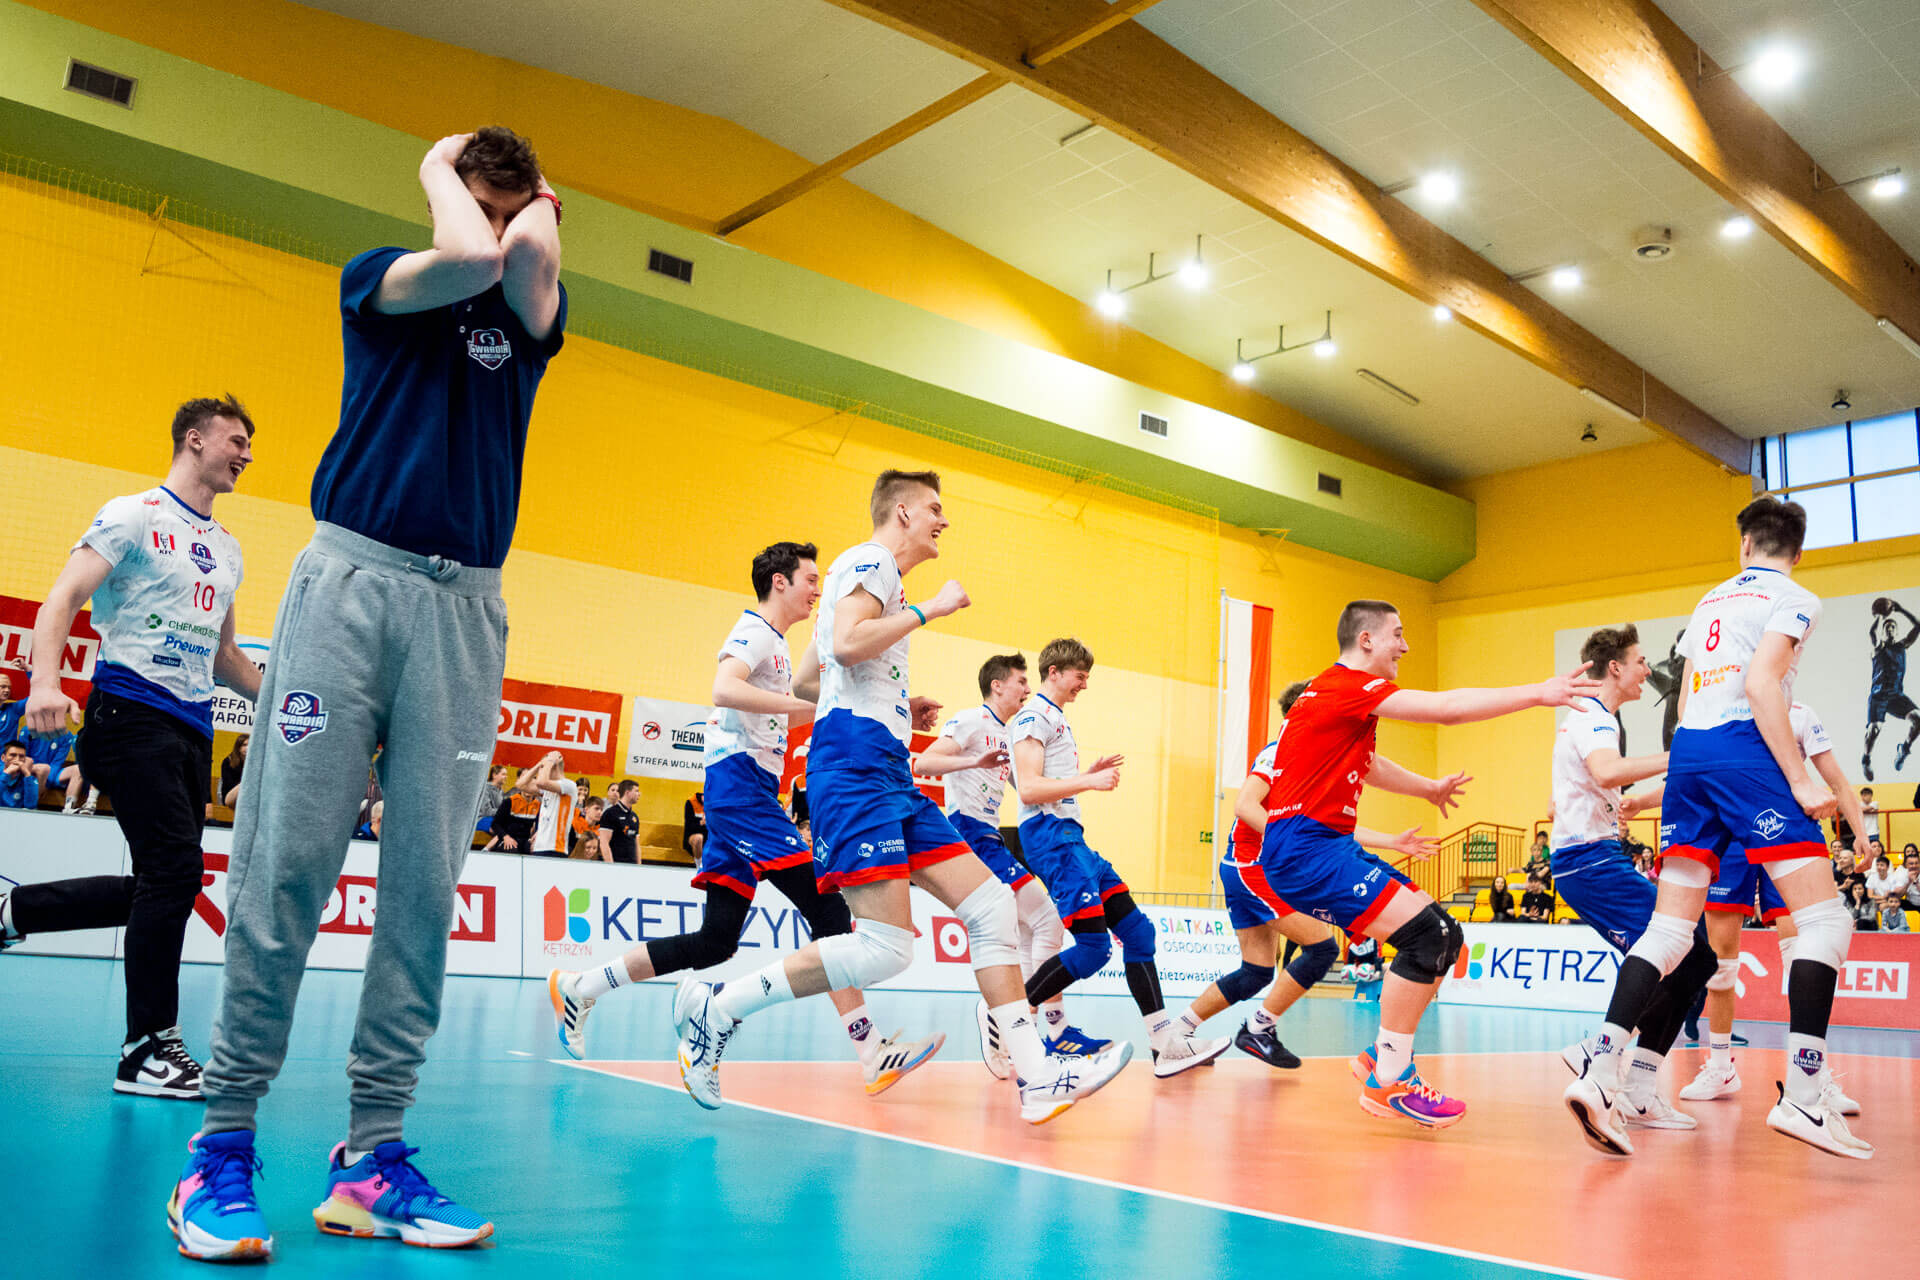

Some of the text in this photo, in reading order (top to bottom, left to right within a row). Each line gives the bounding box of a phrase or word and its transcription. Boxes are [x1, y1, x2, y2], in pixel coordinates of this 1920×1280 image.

[194, 581, 216, 611] 10
[1706, 619, 1720, 652] 8
[671, 729, 705, 744] THERM
[633, 755, 704, 769] STREFA WOLNA
[319, 884, 483, 934] ORN
[1160, 917, 1234, 937] SIATKARS
[543, 943, 592, 957] KĘTRZYN
[1215, 943, 1241, 956] SZKO
[1490, 947, 1621, 989] KĘTRZY
[1837, 966, 1899, 993] LEN
